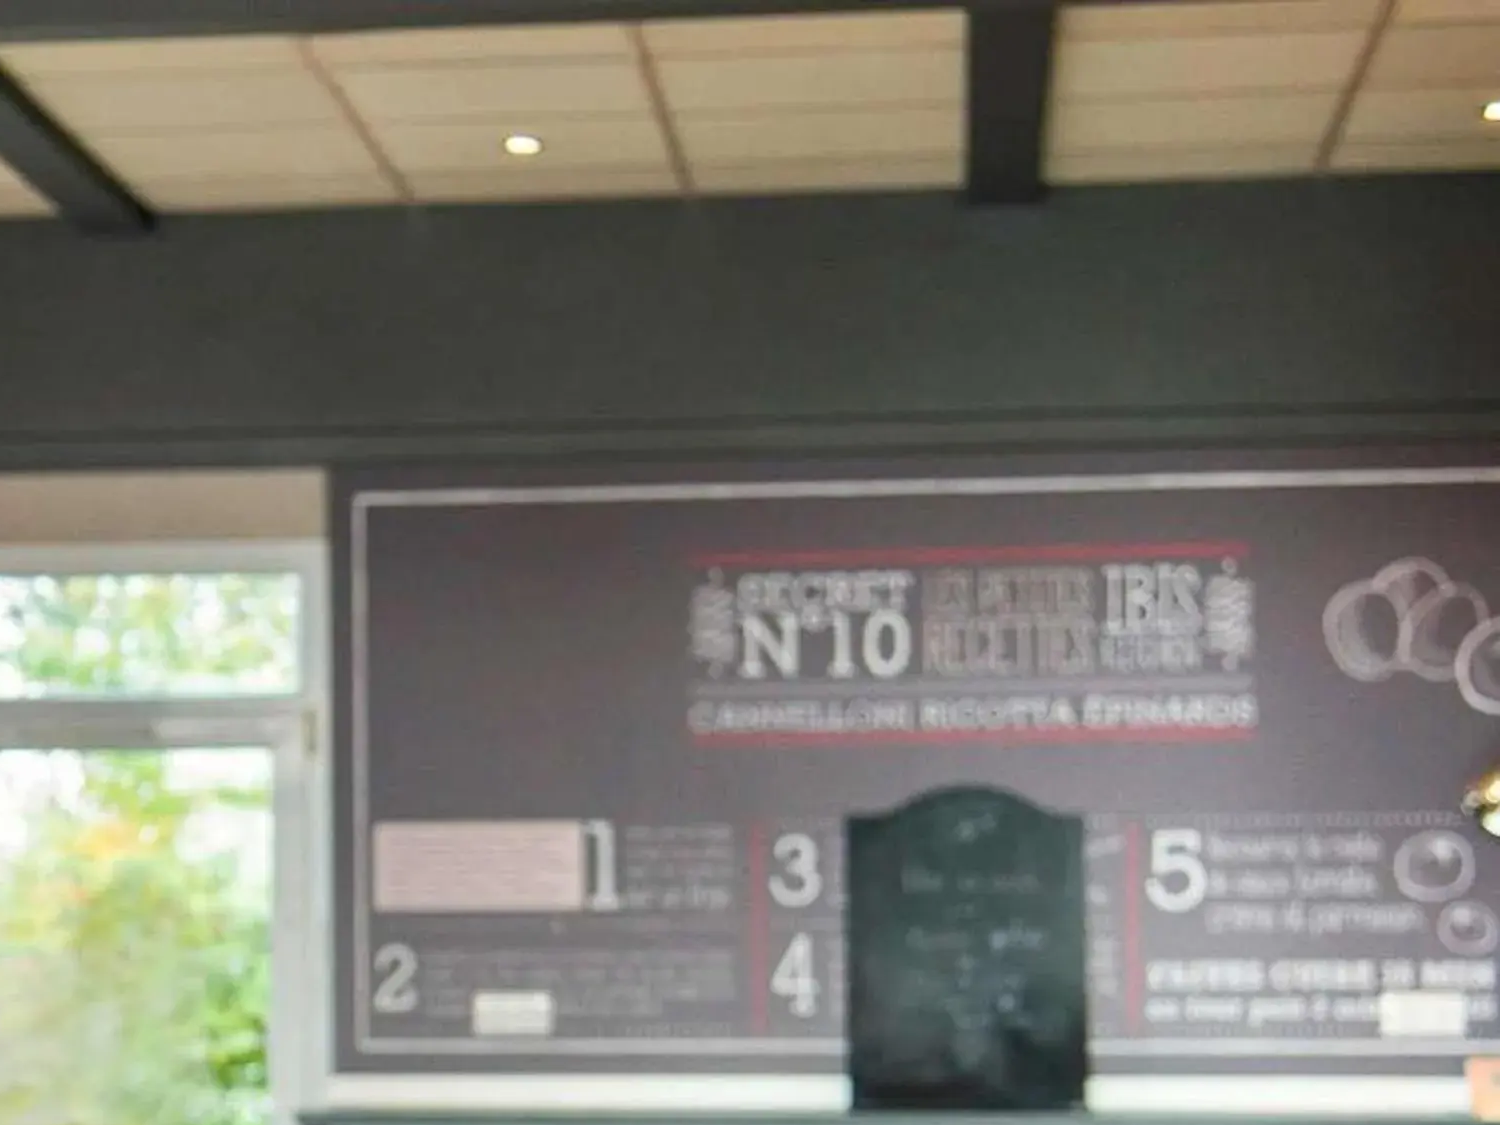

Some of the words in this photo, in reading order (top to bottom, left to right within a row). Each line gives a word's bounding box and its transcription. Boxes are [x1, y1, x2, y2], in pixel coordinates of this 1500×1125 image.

[768, 833, 823, 908] 3
[1145, 828, 1208, 914] 5
[373, 942, 419, 1014] 2
[769, 932, 822, 1018] 4
